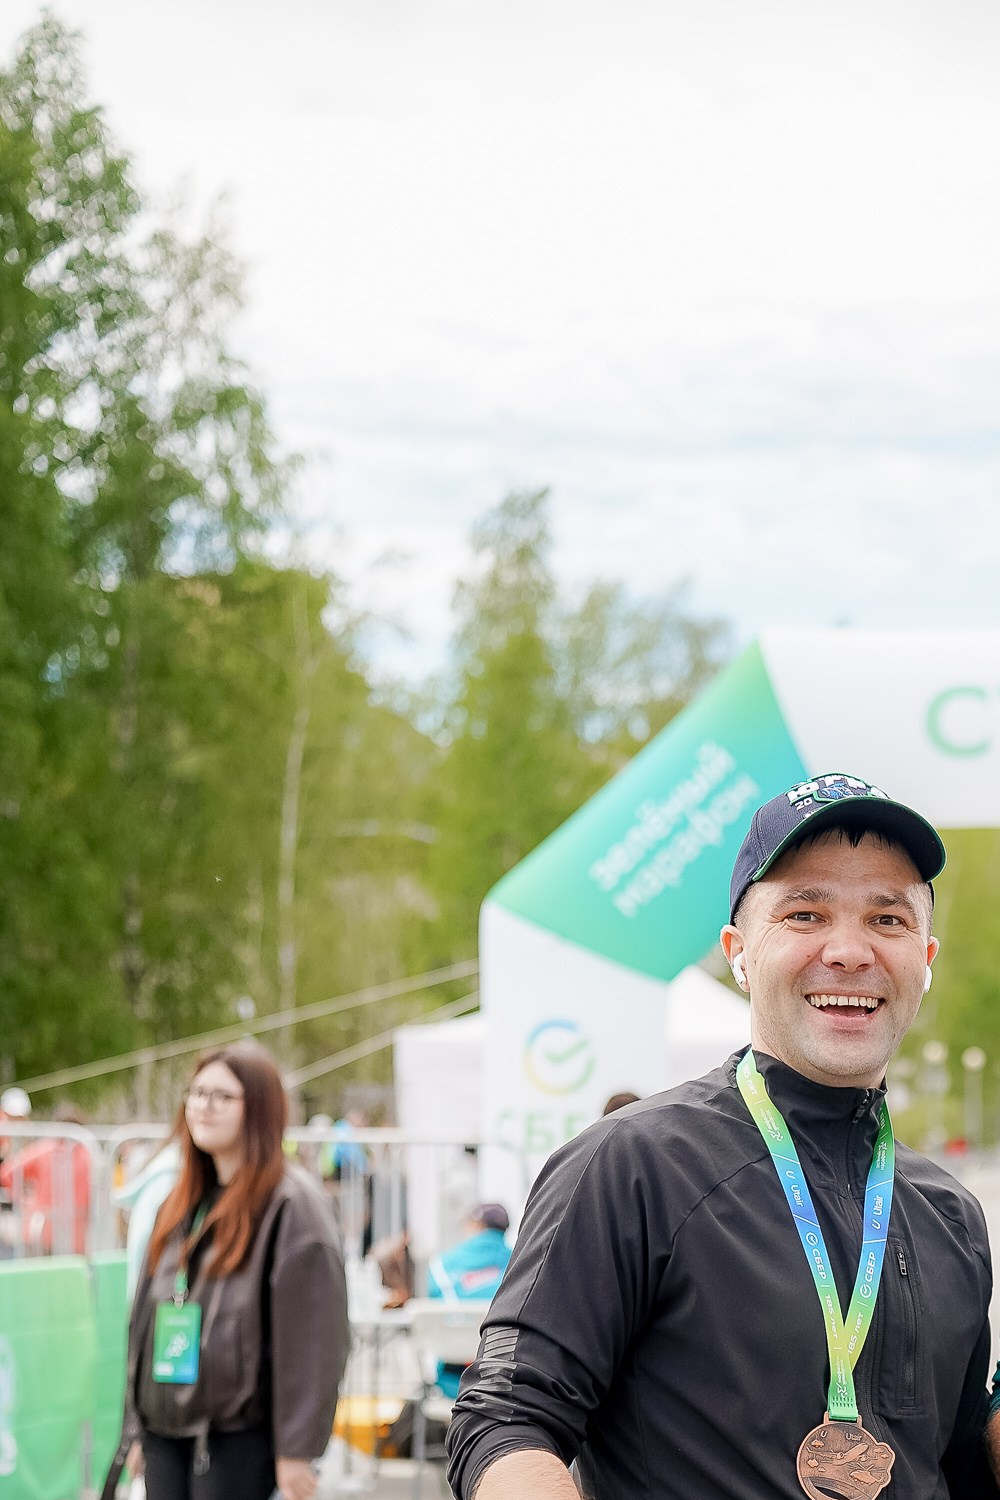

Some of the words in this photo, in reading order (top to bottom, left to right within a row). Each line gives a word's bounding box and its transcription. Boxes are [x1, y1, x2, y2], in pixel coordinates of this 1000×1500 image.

[790, 1185, 804, 1207] Utair
[873, 1194, 884, 1216] Utair
[812, 1248, 827, 1280] СБЕР
[865, 1251, 876, 1282] СБЕР
[825, 1294, 834, 1315] 185
